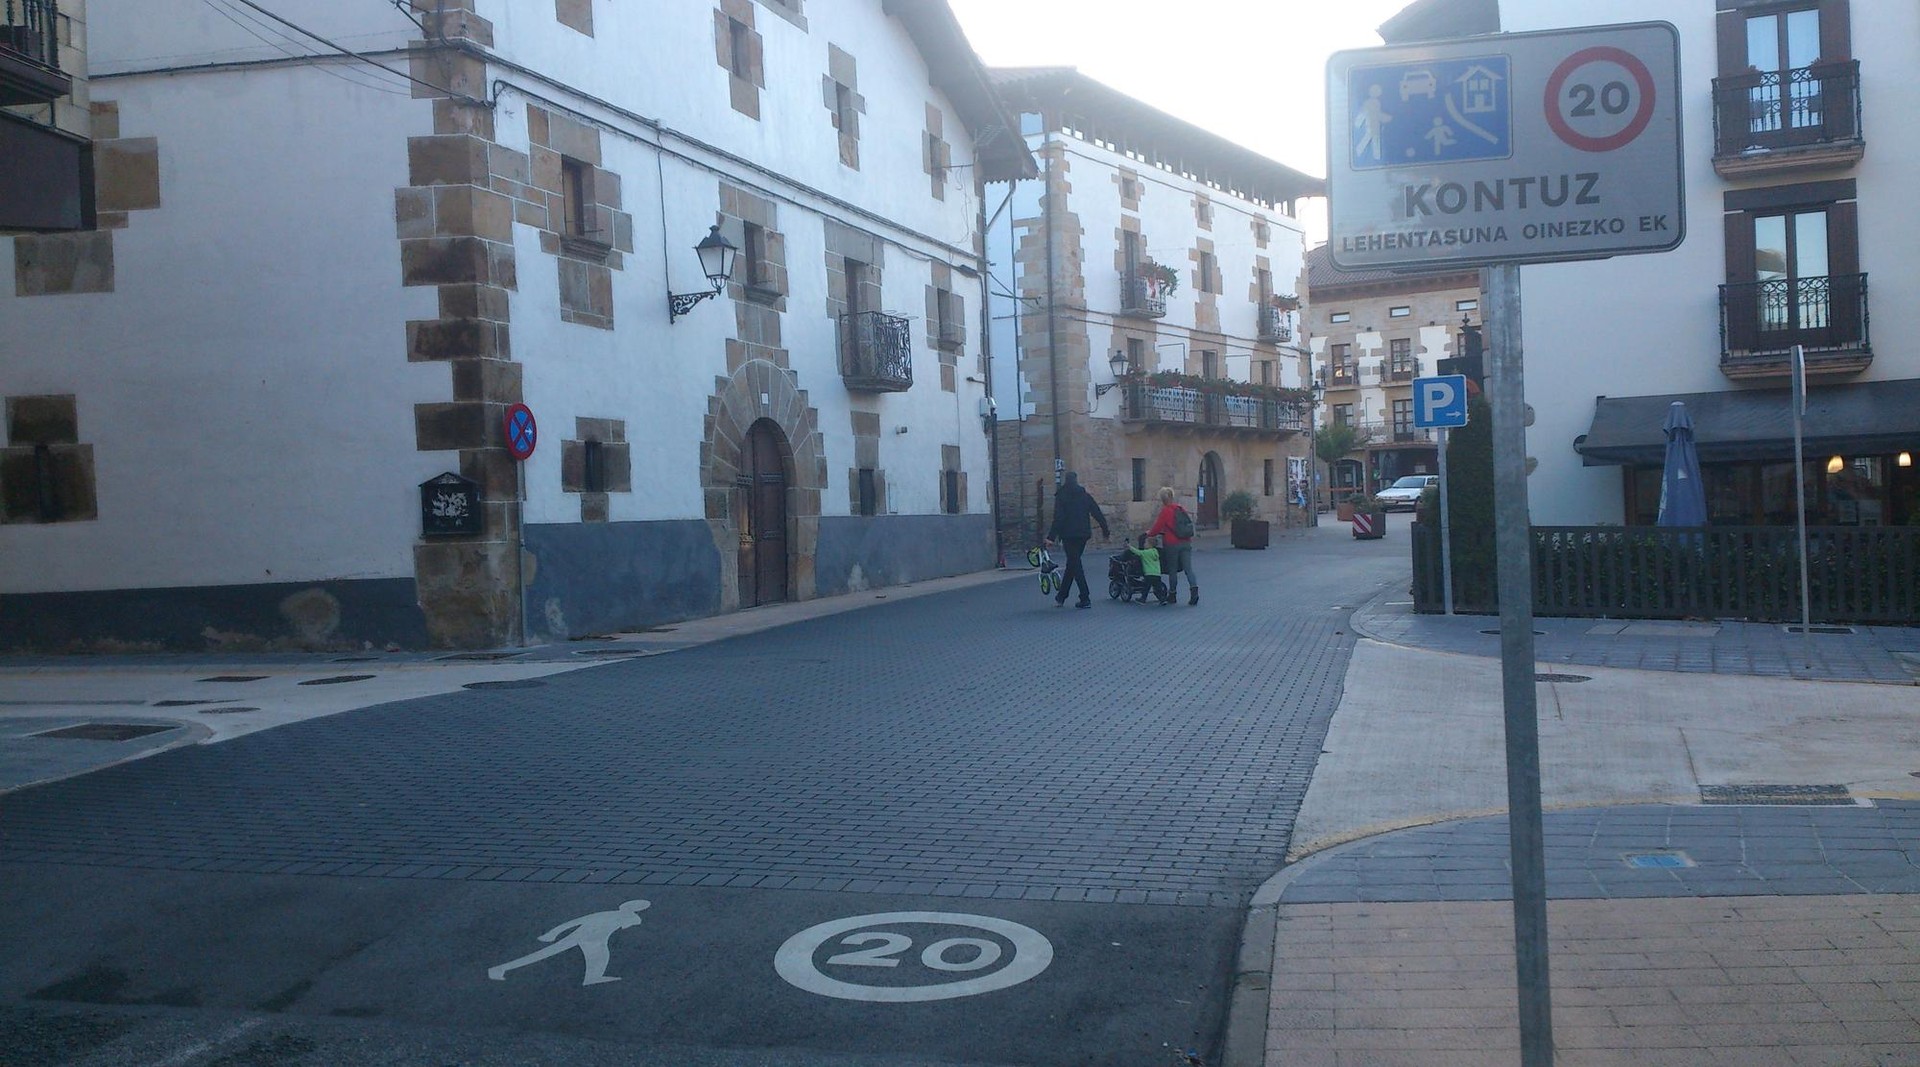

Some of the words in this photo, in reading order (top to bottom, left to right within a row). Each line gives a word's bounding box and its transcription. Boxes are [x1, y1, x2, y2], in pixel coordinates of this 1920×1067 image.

[1568, 81, 1630, 117] 20
[1405, 172, 1601, 217] KONTUZ
[1343, 226, 1508, 253] LEHENTASUNA
[1523, 217, 1625, 239] OINEZKO
[1639, 214, 1668, 232] EK
[1423, 382, 1455, 422] P
[826, 932, 1002, 972] 20
